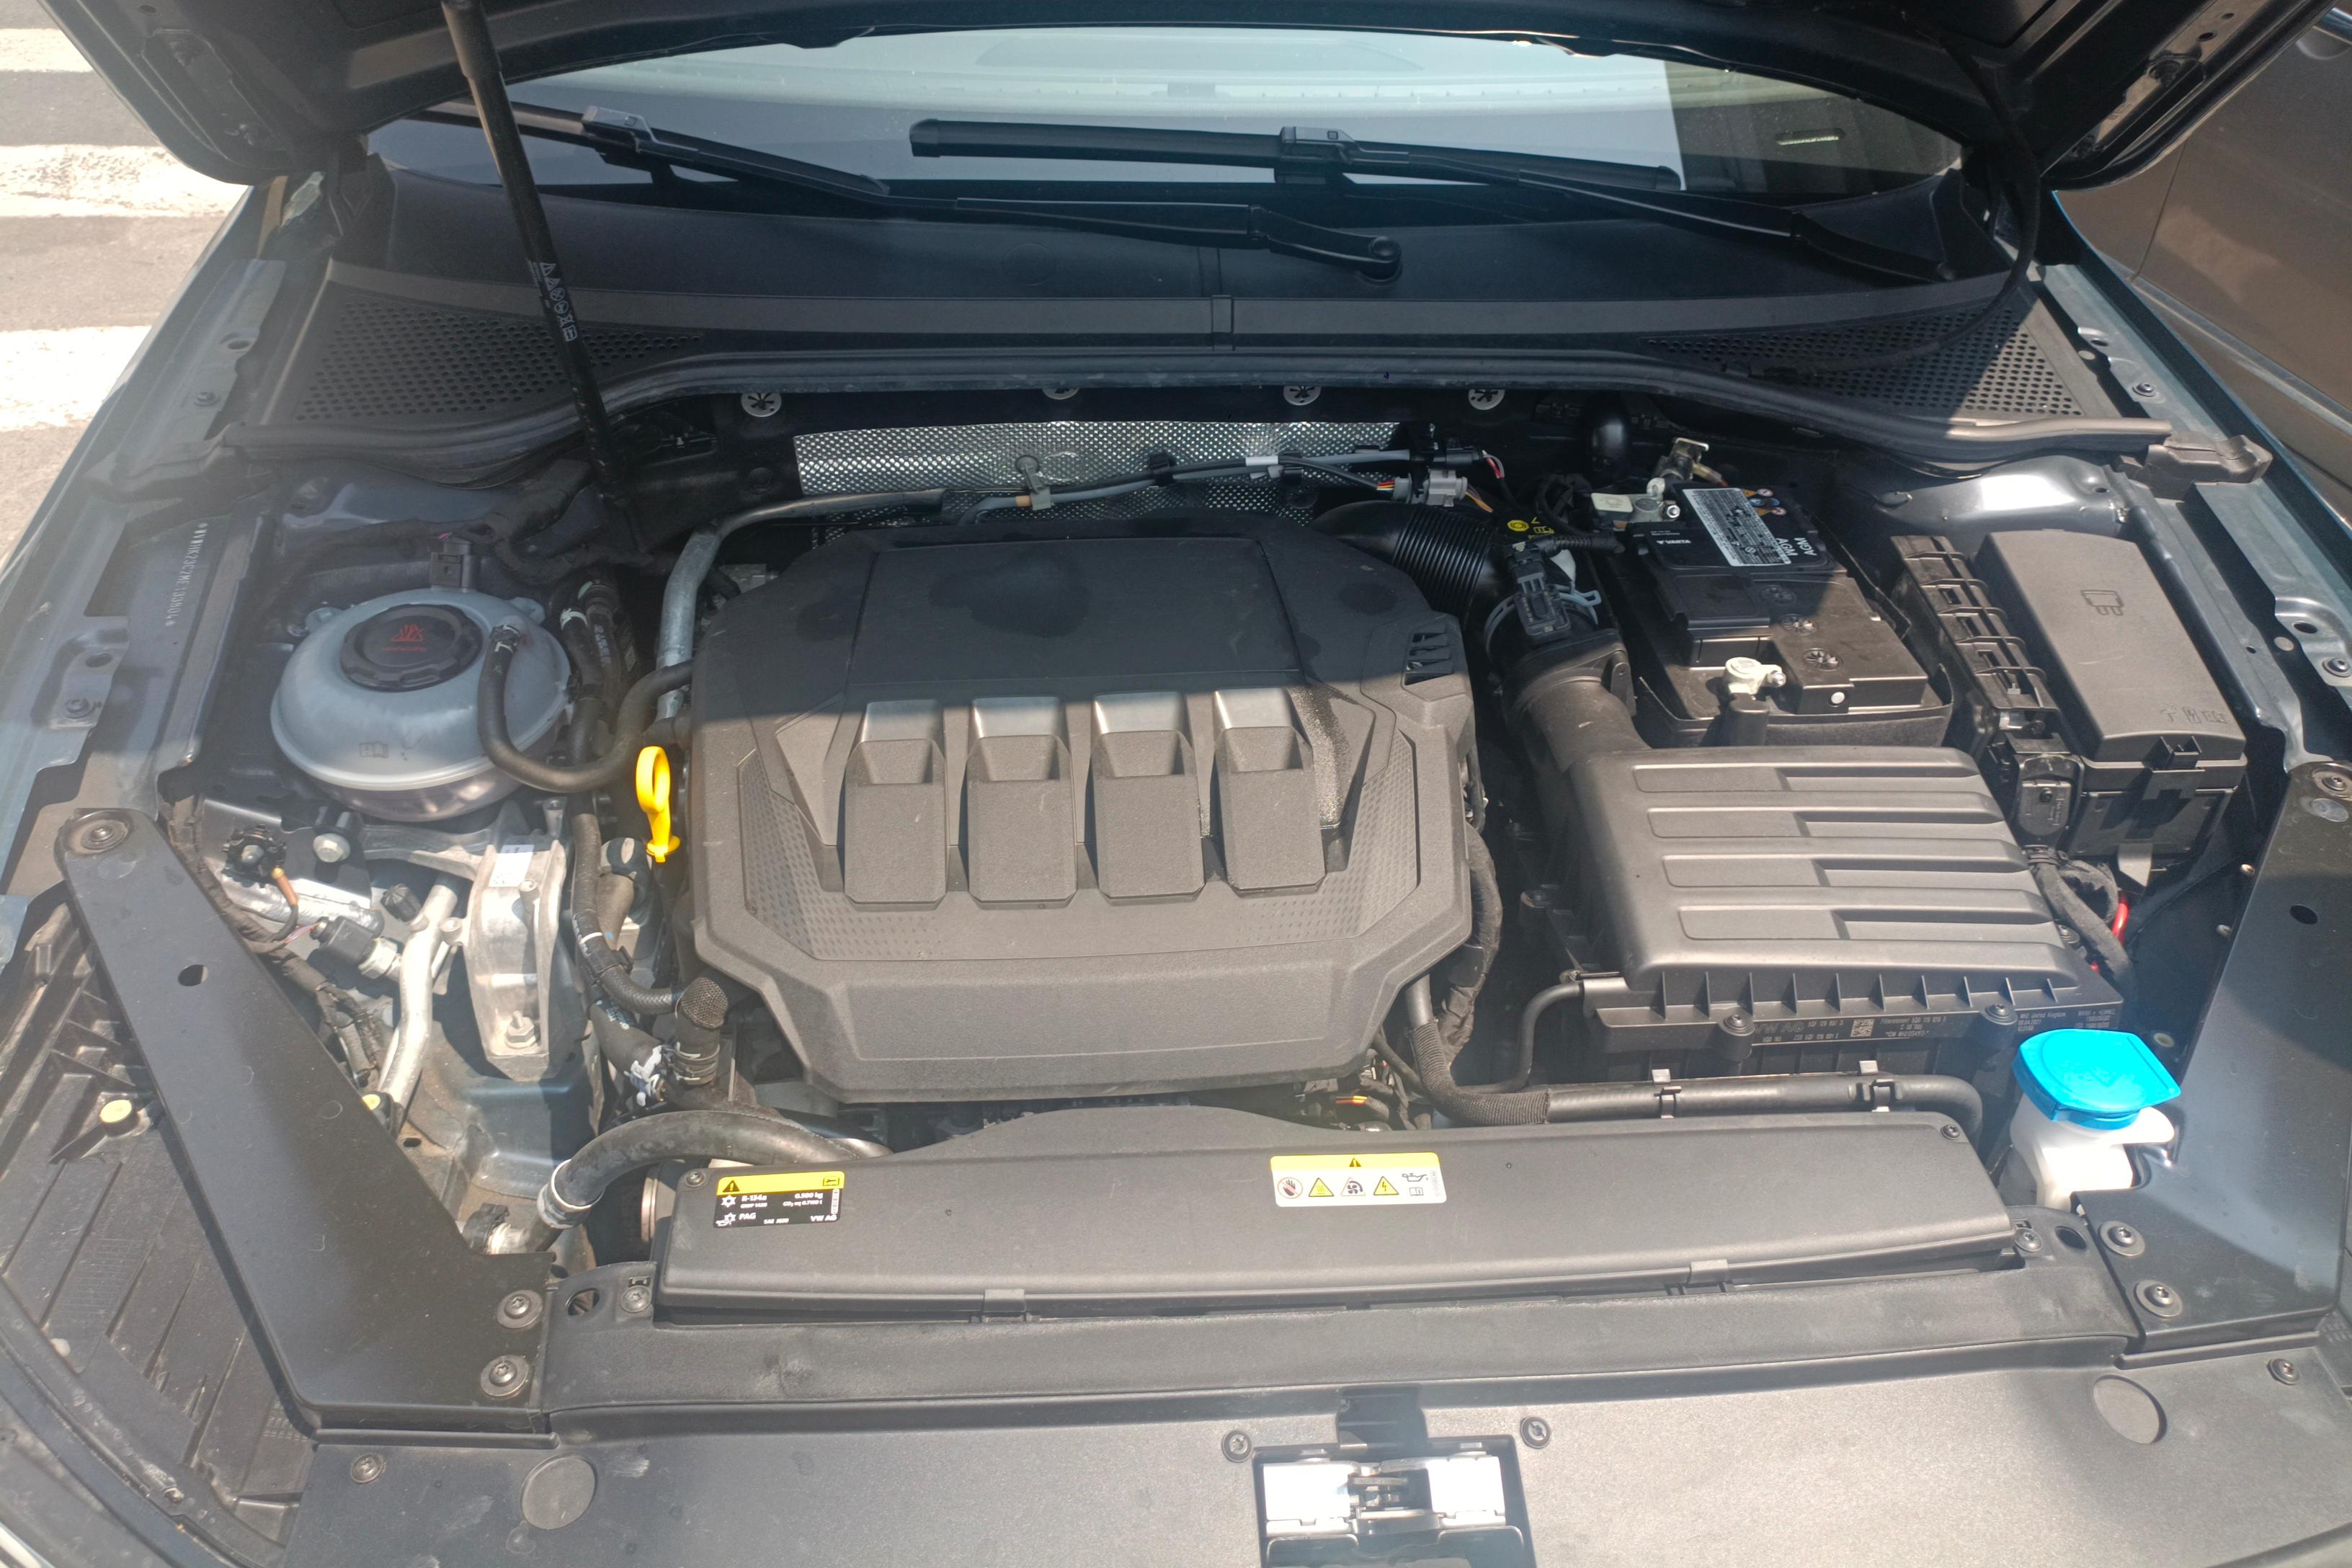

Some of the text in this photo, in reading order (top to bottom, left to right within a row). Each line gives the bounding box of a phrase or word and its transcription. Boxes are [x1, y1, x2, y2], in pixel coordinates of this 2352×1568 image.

[1776, 538, 1799, 556] AGM
[1793, 537, 1817, 556] AGM
[1753, 1022, 1805, 1034] VW AG
